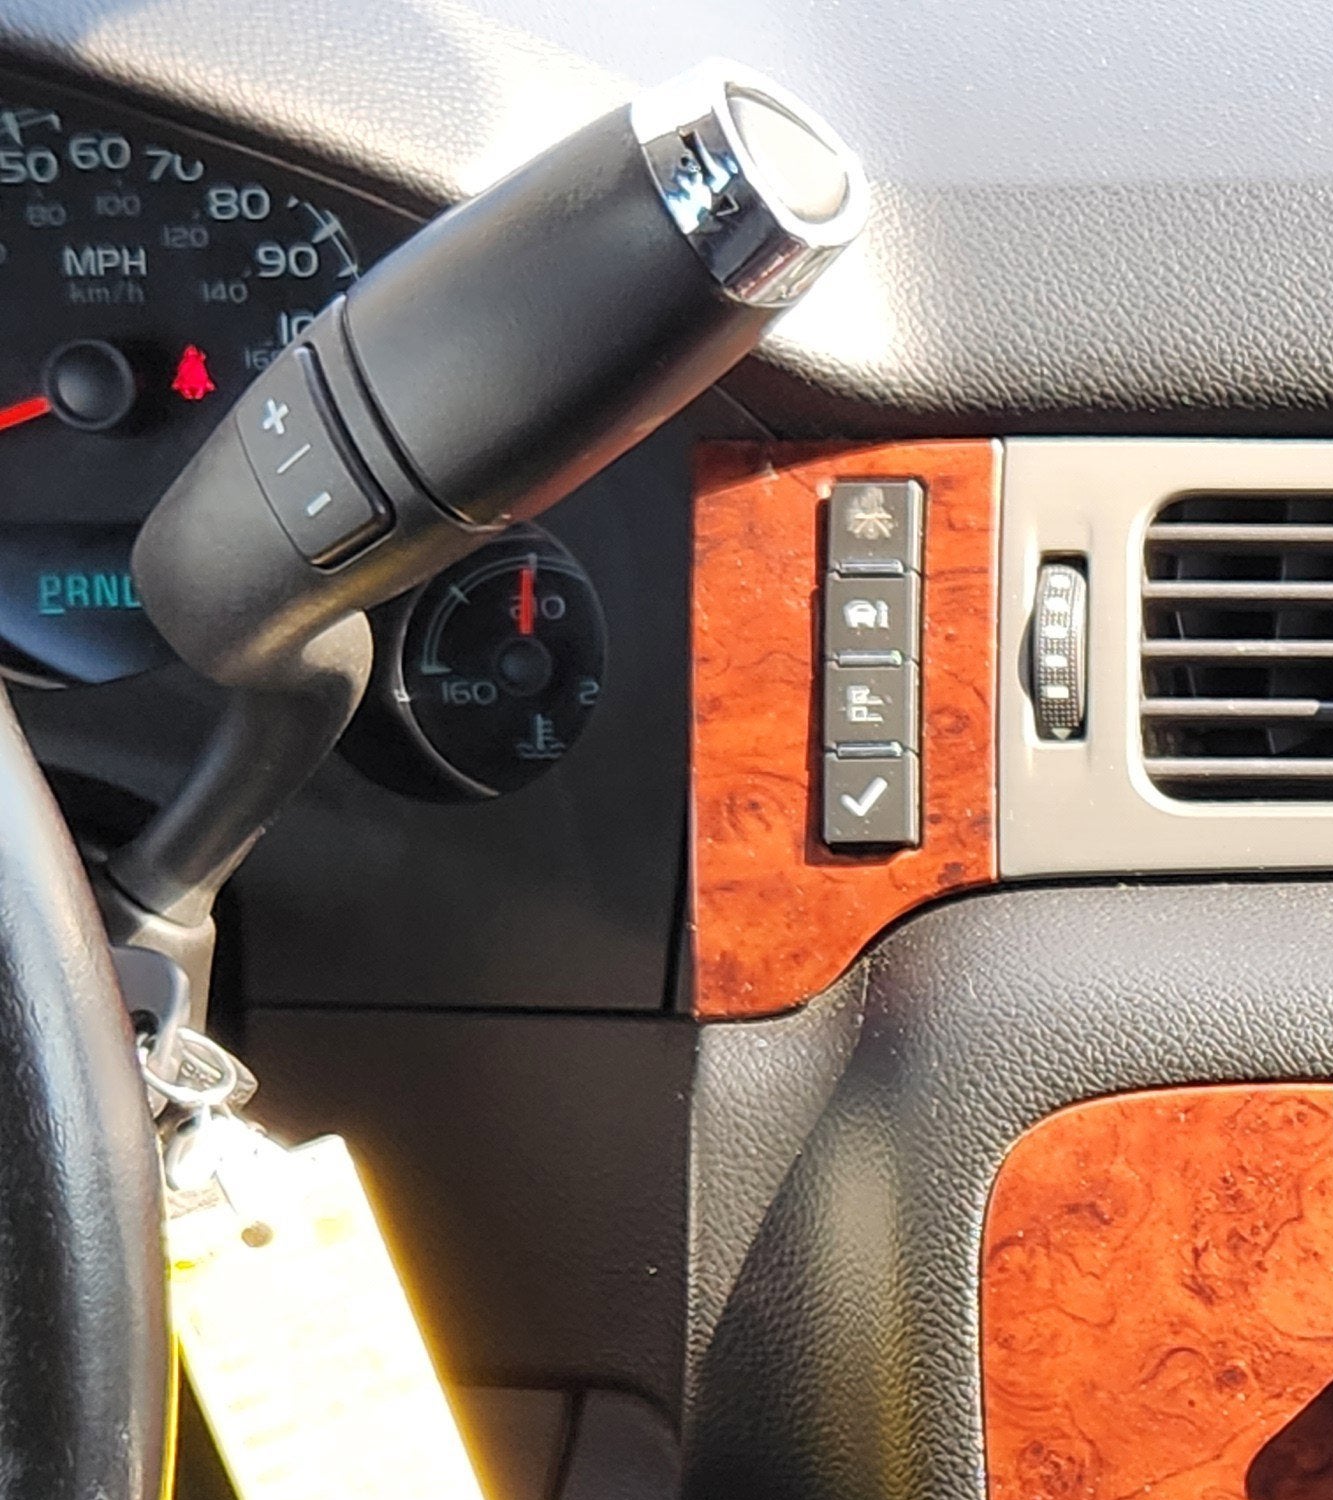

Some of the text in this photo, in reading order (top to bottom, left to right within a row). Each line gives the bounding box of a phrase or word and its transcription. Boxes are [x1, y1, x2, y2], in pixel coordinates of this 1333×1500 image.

[0, 150, 58, 183] 50
[69, 136, 131, 169] 60
[146, 151, 204, 181] 70
[208, 187, 270, 220] 80
[163, 226, 209, 249] 120
[63, 246, 147, 276] MPH
[257, 244, 319, 278] 90
[69, 281, 146, 304] km/h
[203, 281, 248, 304] 140
[442, 681, 498, 704] 160
